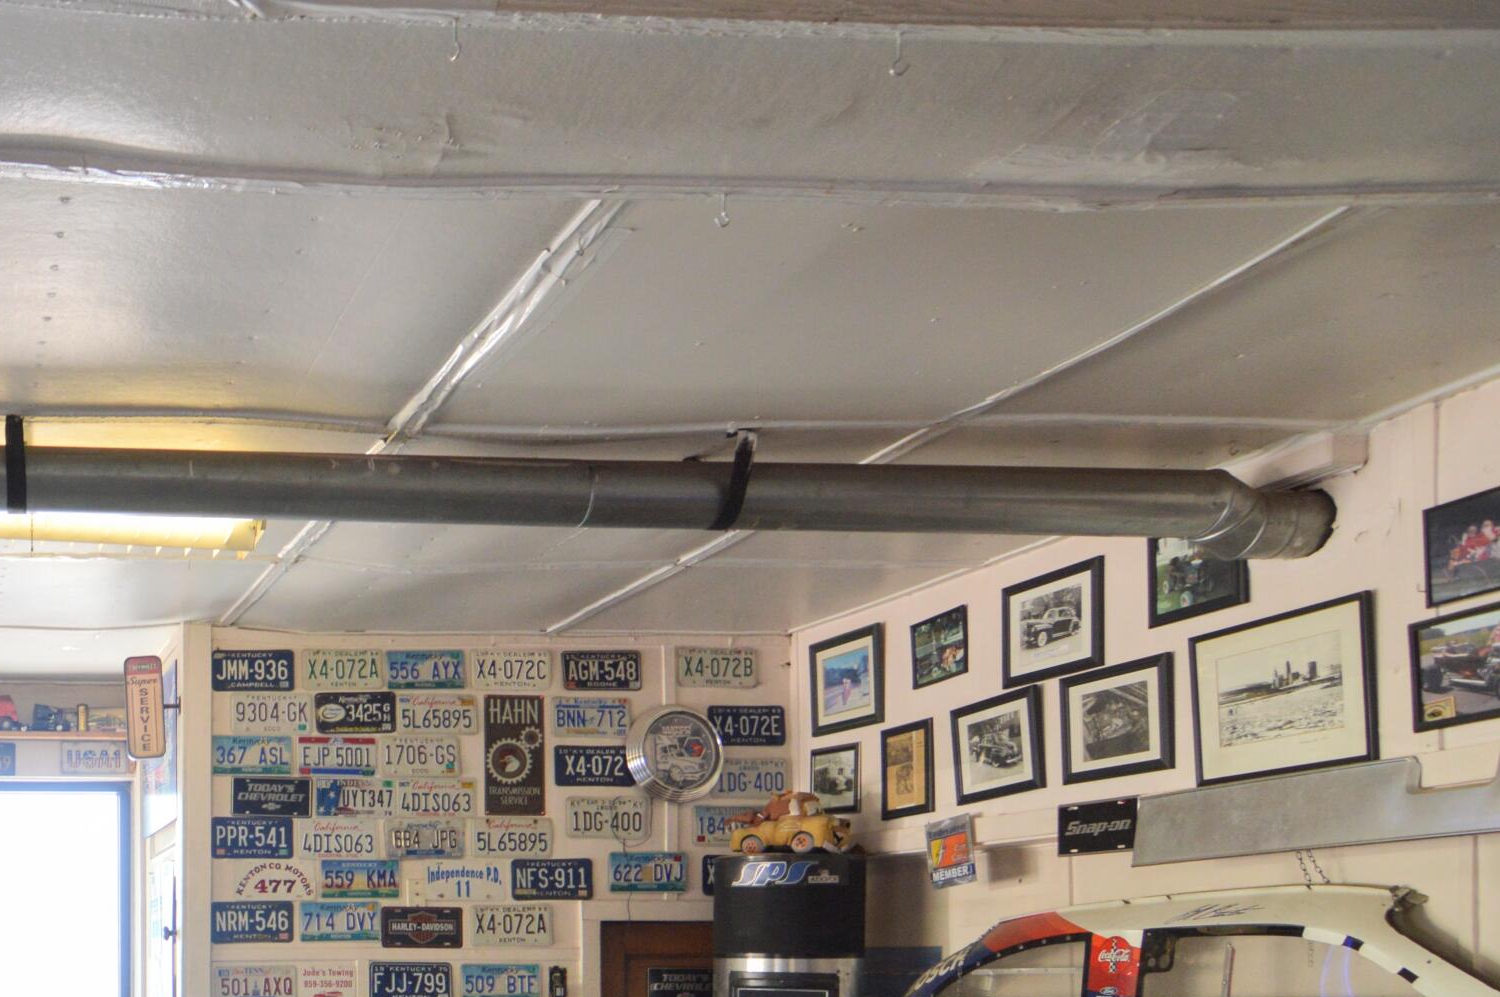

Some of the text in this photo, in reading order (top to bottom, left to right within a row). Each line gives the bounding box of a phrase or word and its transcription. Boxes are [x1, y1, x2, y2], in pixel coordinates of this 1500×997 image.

[216, 659, 288, 680] JMM-936
[308, 658, 379, 680] X4-072A
[390, 661, 461, 680] 556 AYX
[477, 660, 547, 679] X4-072C
[568, 661, 636, 681] AGM-548
[684, 657, 753, 678] X4-072B
[130, 676, 156, 687] Super
[139, 688, 151, 751] SERVICE
[236, 702, 307, 722] 9304-GK
[346, 703, 381, 723] 3425
[402, 709, 471, 728] 5L65895
[489, 699, 538, 725] HAHN
[557, 710, 626, 728] BNN 712
[714, 715, 781, 736] X4-072E
[216, 746, 288, 765] 367 ASL
[303, 747, 370, 767] EJP 5001
[385, 745, 456, 765] 1706-GS
[565, 755, 624, 775] X4-072
[247, 783, 295, 792] TODAY'S
[489, 786, 540, 795] TRANSMISSION
[718, 771, 784, 793] 1DG-400
[238, 792, 305, 802] CHEVROLET
[341, 789, 393, 808] UYT347
[500, 796, 528, 805] SERVICE
[573, 811, 642, 832] 1DG-400
[1065, 819, 1131, 836] Snap-on
[216, 825, 287, 848] PPR-541
[477, 832, 548, 852] 5L65895
[236, 862, 314, 896] KENTON CO MOTORS
[324, 870, 397, 888] 559 KMA
[428, 866, 502, 885] Independence P.D.
[516, 867, 587, 889] NFS-911
[614, 864, 683, 882] 622 DVJ
[932, 866, 969, 880] MEMBER
[254, 879, 297, 893] 477
[456, 880, 470, 897] 11
[216, 910, 289, 932] NRM-546
[304, 912, 376, 931] 714 DVY
[391, 922, 454, 931] HARLEY-DAVIDSON
[476, 914, 547, 935] X4-072A
[328, 969, 353, 978] Towing
[373, 972, 446, 993] FJJ-799
[221, 977, 292, 996] 501 AXQ
[465, 975, 495, 993] 509
[653, 983, 711, 991] CHEVROLE
